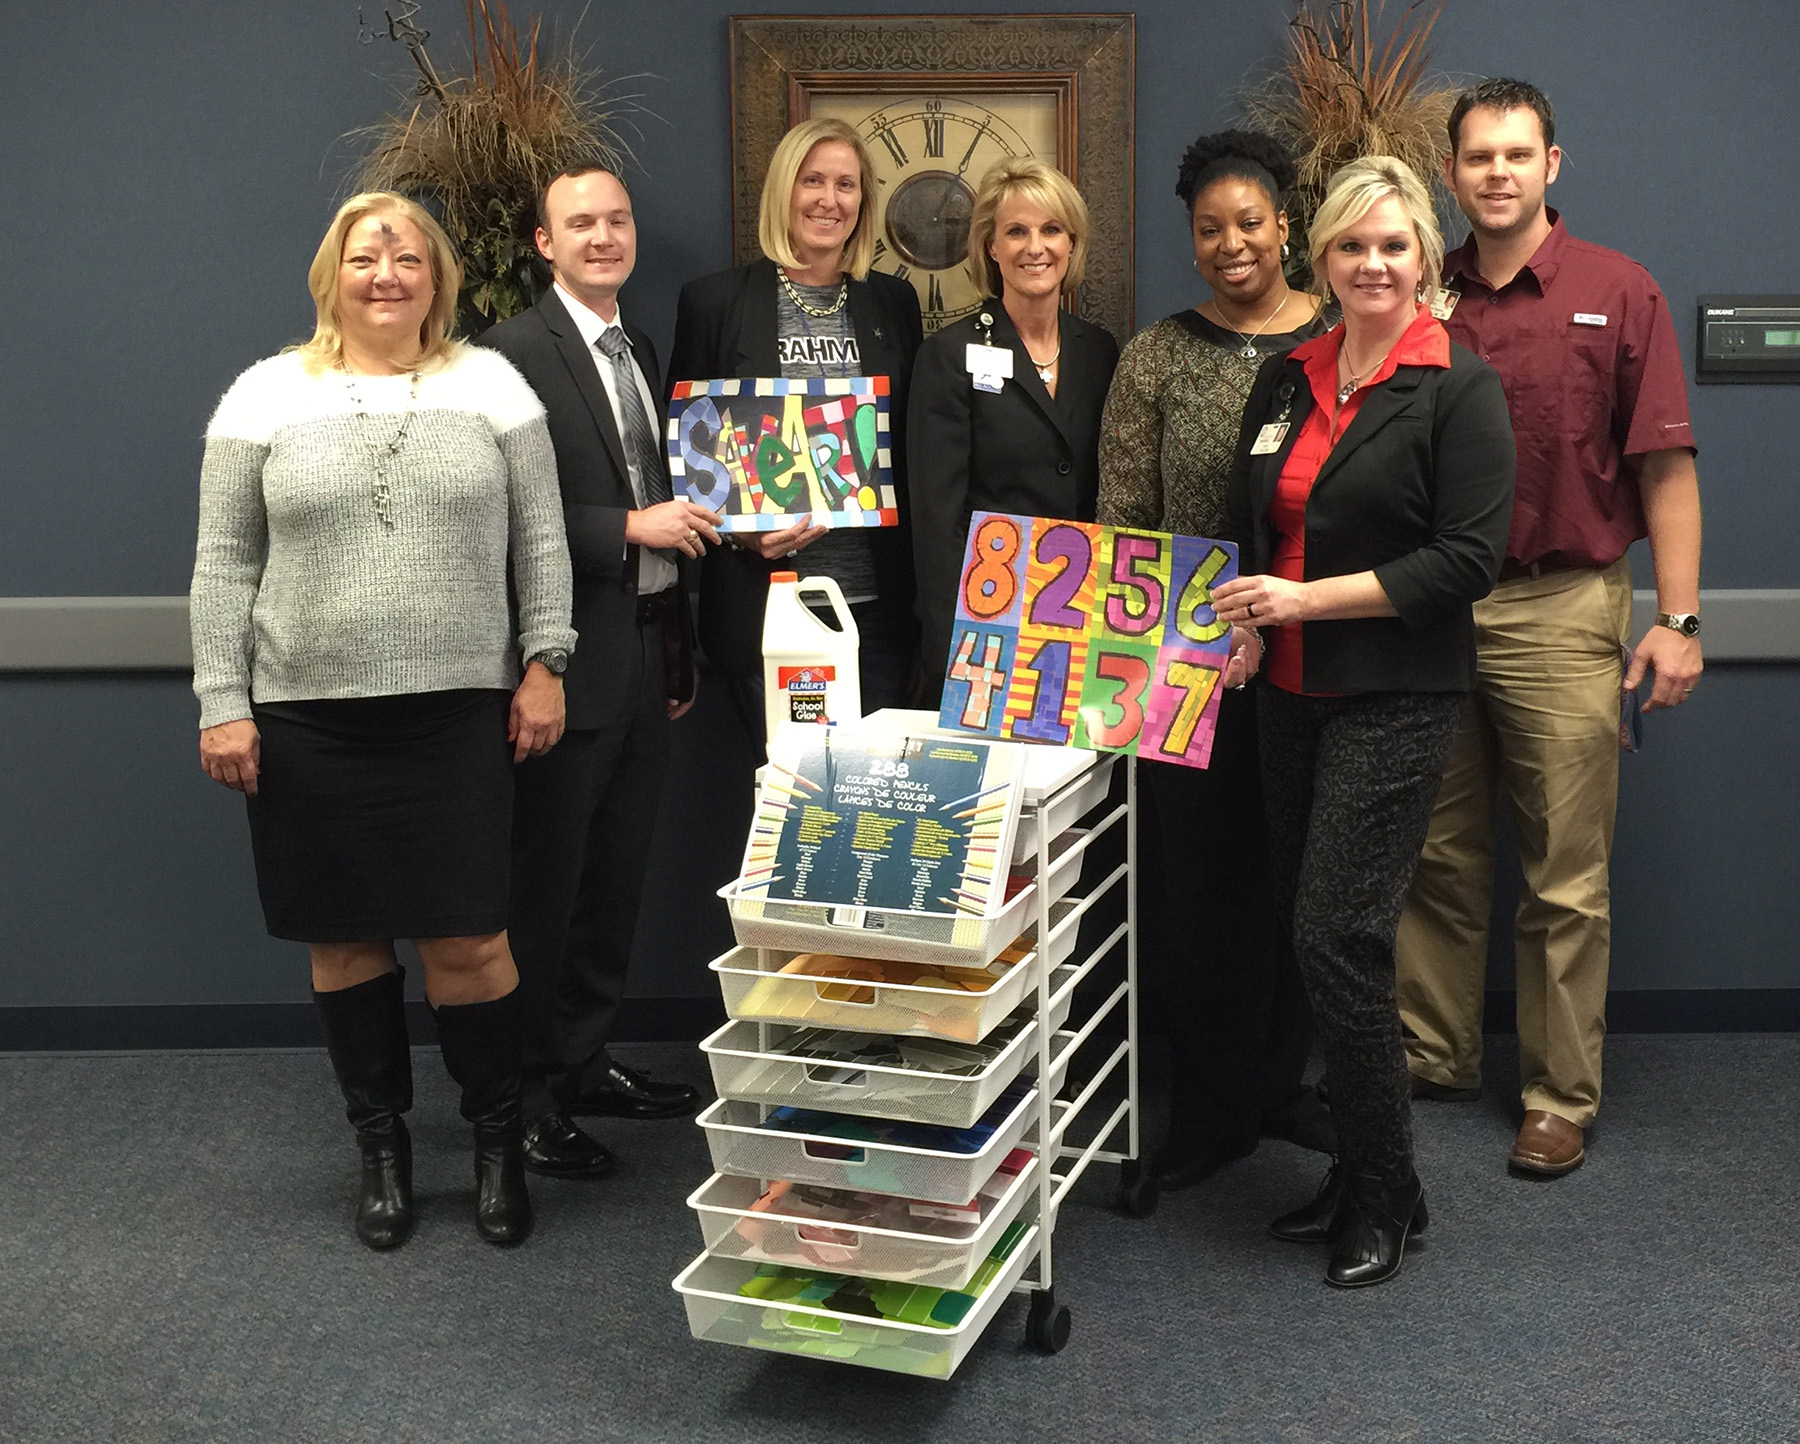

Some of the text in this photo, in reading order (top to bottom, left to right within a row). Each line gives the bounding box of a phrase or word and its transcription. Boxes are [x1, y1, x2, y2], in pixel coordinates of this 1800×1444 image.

[925, 100, 942, 112] 60
[870, 113, 888, 130] 55
[982, 115, 993, 127] 5
[922, 118, 944, 158] XII
[963, 518, 1232, 644] 8 2 5 6
[790, 682, 826, 690] ELMER'S
[948, 630, 1221, 758] 4 1 3 7
[792, 701, 824, 711] School
[868, 760, 910, 779] 288
[845, 775, 930, 792] COLORED PENCILS
[833, 784, 937, 803] CRAYONS DE COULEUR
[837, 795, 927, 813] LAPICES DE COLOR
